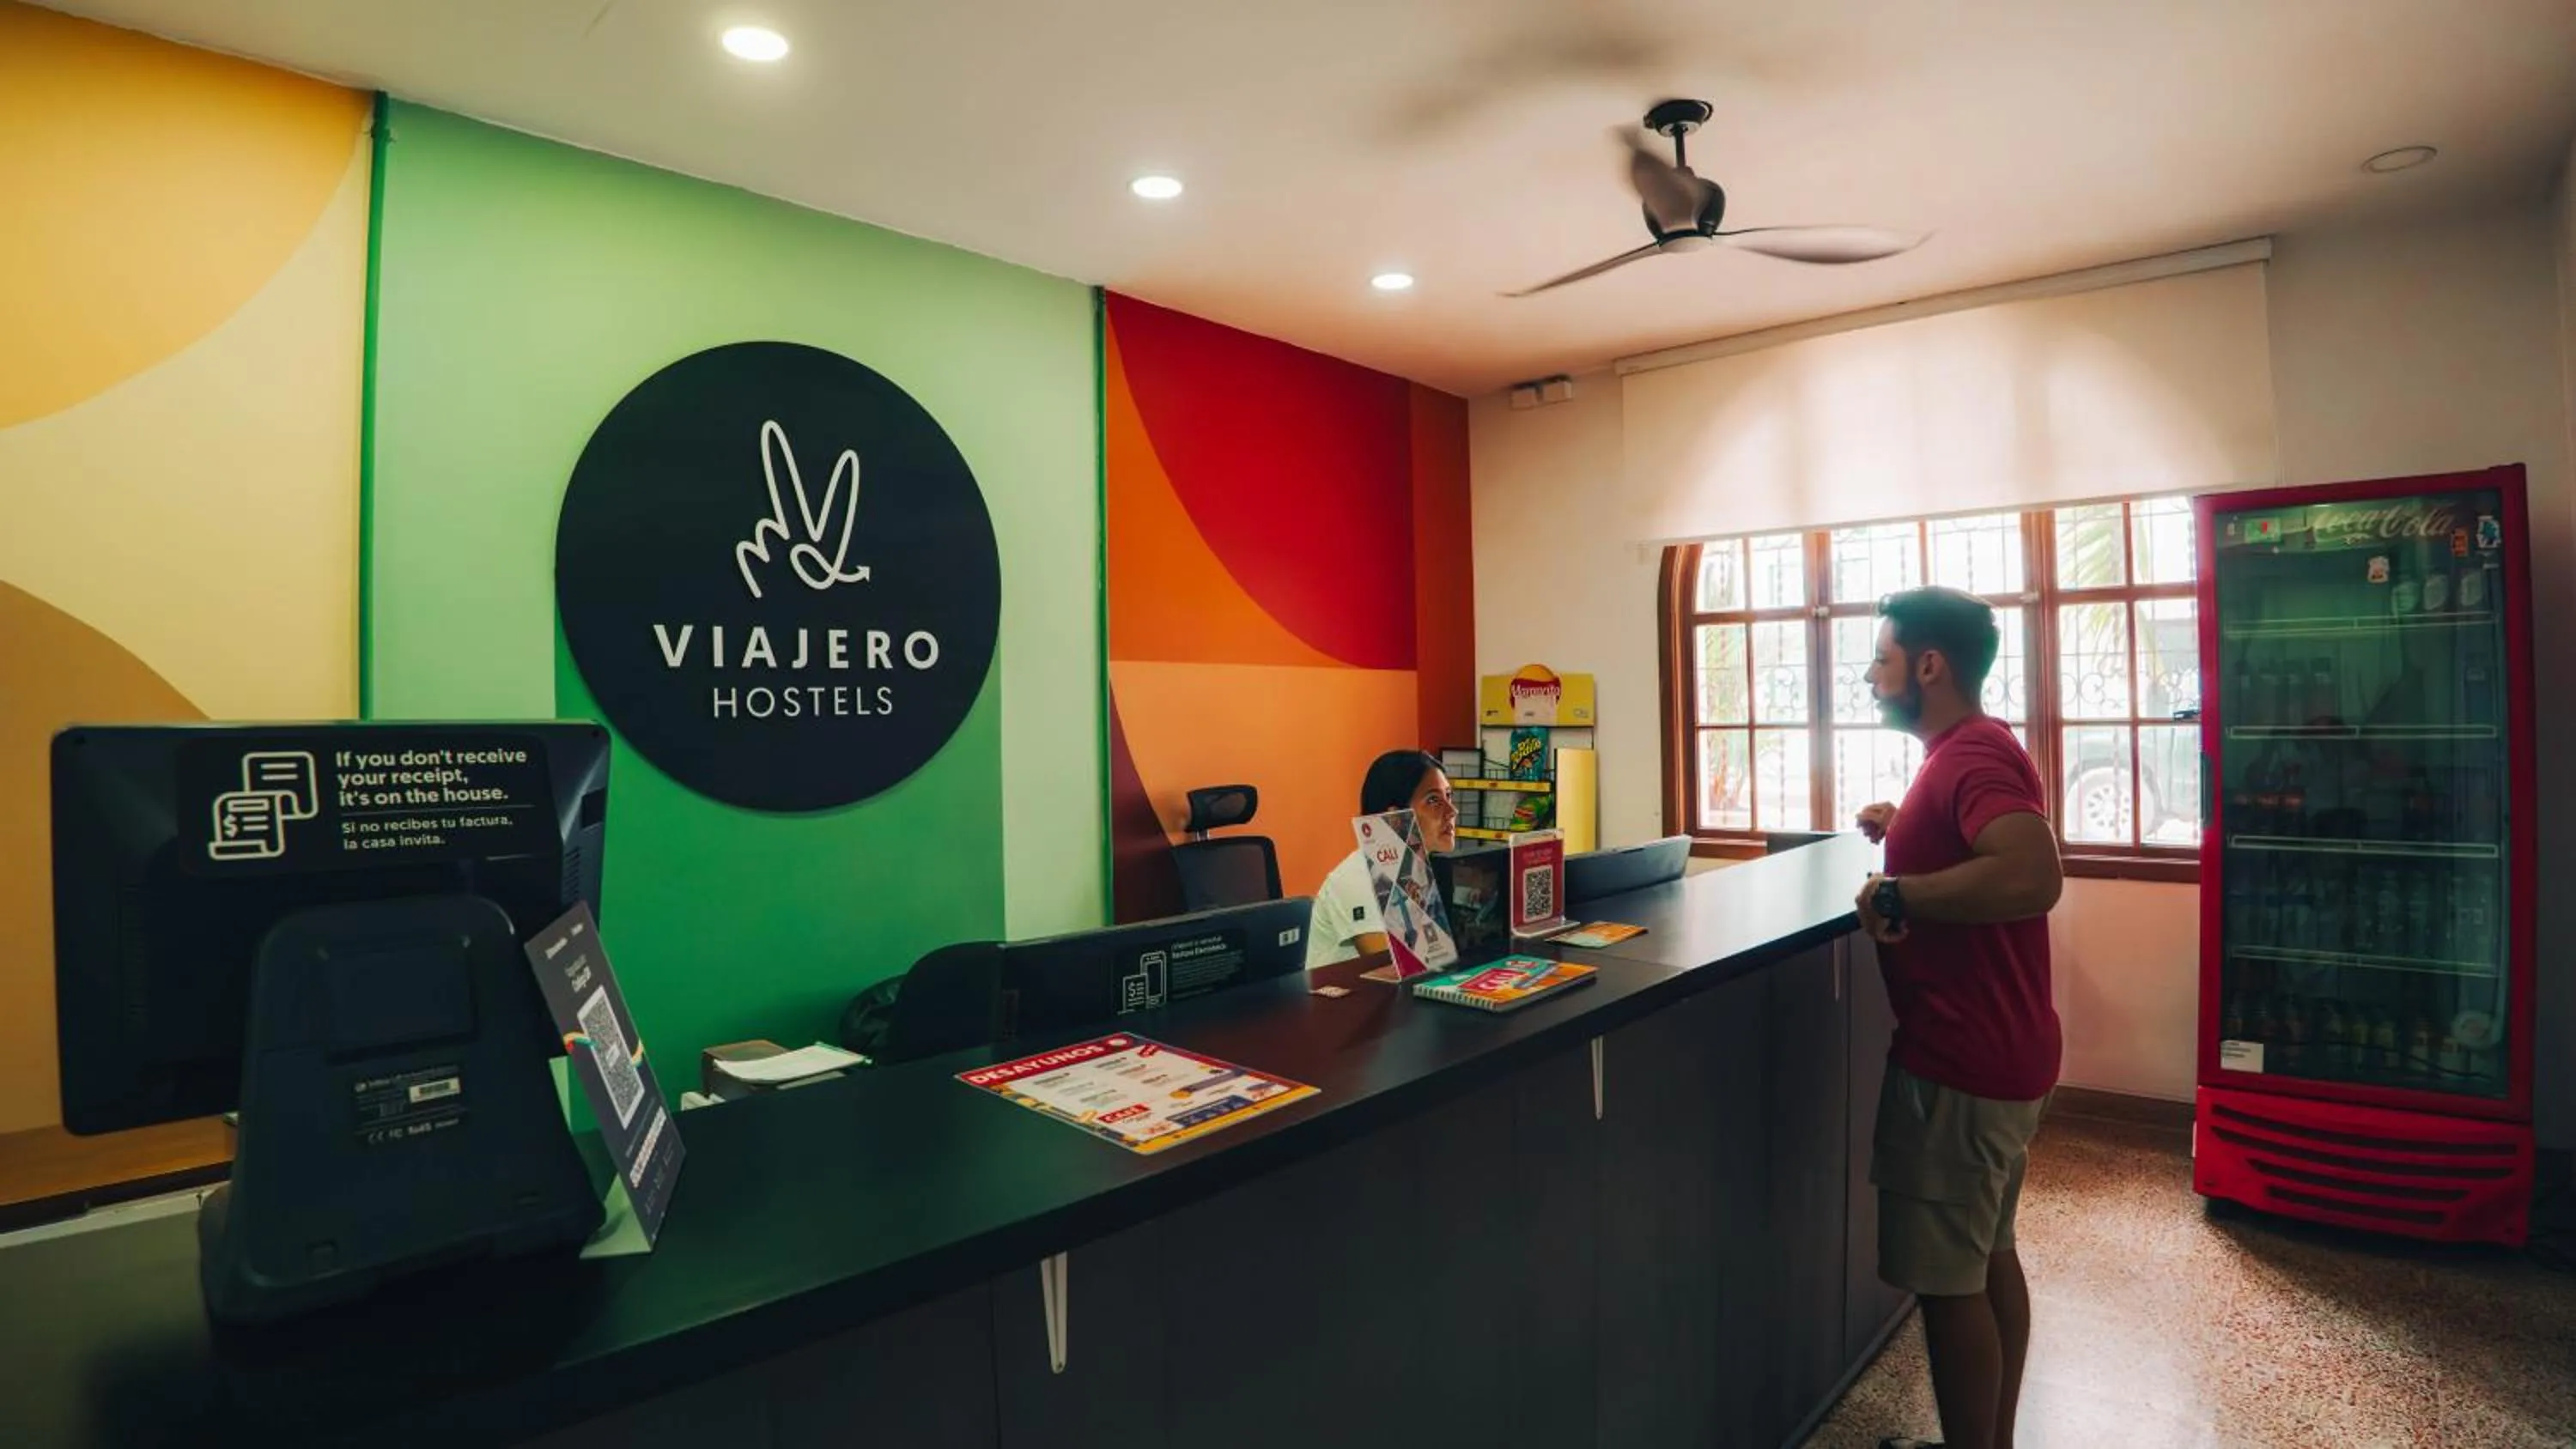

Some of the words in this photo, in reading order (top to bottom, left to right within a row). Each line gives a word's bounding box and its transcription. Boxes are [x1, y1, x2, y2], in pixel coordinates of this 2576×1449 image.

[653, 624, 940, 670] VIAJERO
[713, 686, 893, 718] HOSTELS
[336, 751, 351, 767] If
[355, 753, 396, 770] you
[399, 749, 453, 767] don't
[457, 748, 527, 764] receive
[337, 772, 386, 790] your
[392, 767, 469, 785] receipt,
[338, 791, 370, 807] it's
[374, 792, 402, 806] on
[405, 788, 440, 804] the
[443, 787, 509, 803] house.
[343, 822, 356, 834] Si
[359, 822, 380, 833] no
[384, 818, 438, 831] recibes
[441, 816, 456, 828] tu
[343, 840, 358, 850] la
[361, 837, 396, 849] casa
[399, 834, 447, 846] invita.
[1376, 846, 1400, 864] CALI
[969, 1046, 1104, 1086] DESAYUNOS
